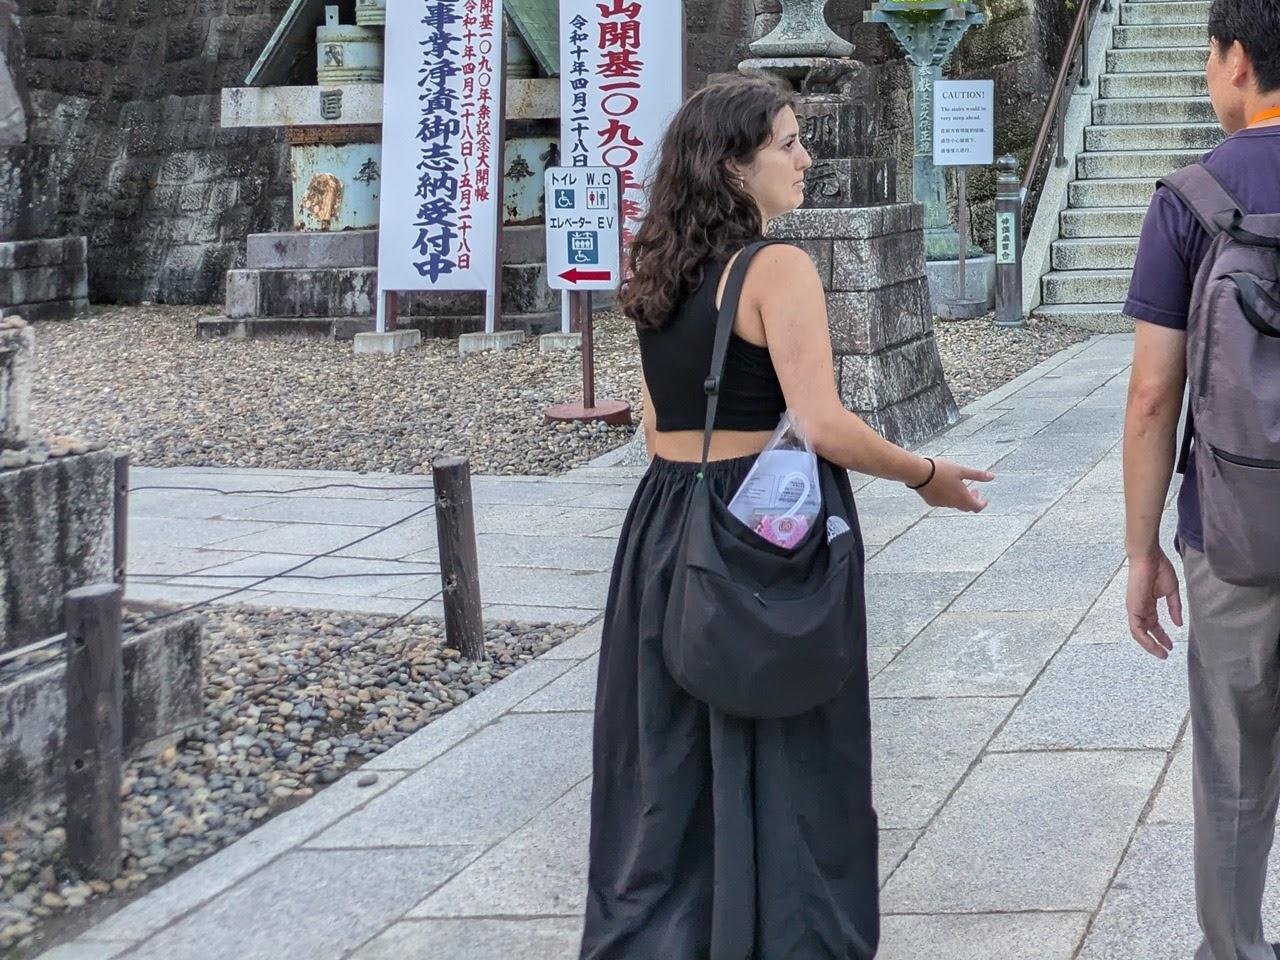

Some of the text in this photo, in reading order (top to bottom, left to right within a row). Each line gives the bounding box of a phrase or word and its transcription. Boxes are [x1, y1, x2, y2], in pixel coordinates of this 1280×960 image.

[942, 91, 985, 100] CAUTION!
[551, 172, 612, 186] トイレ W.C
[549, 216, 614, 229] エレベーター EV
